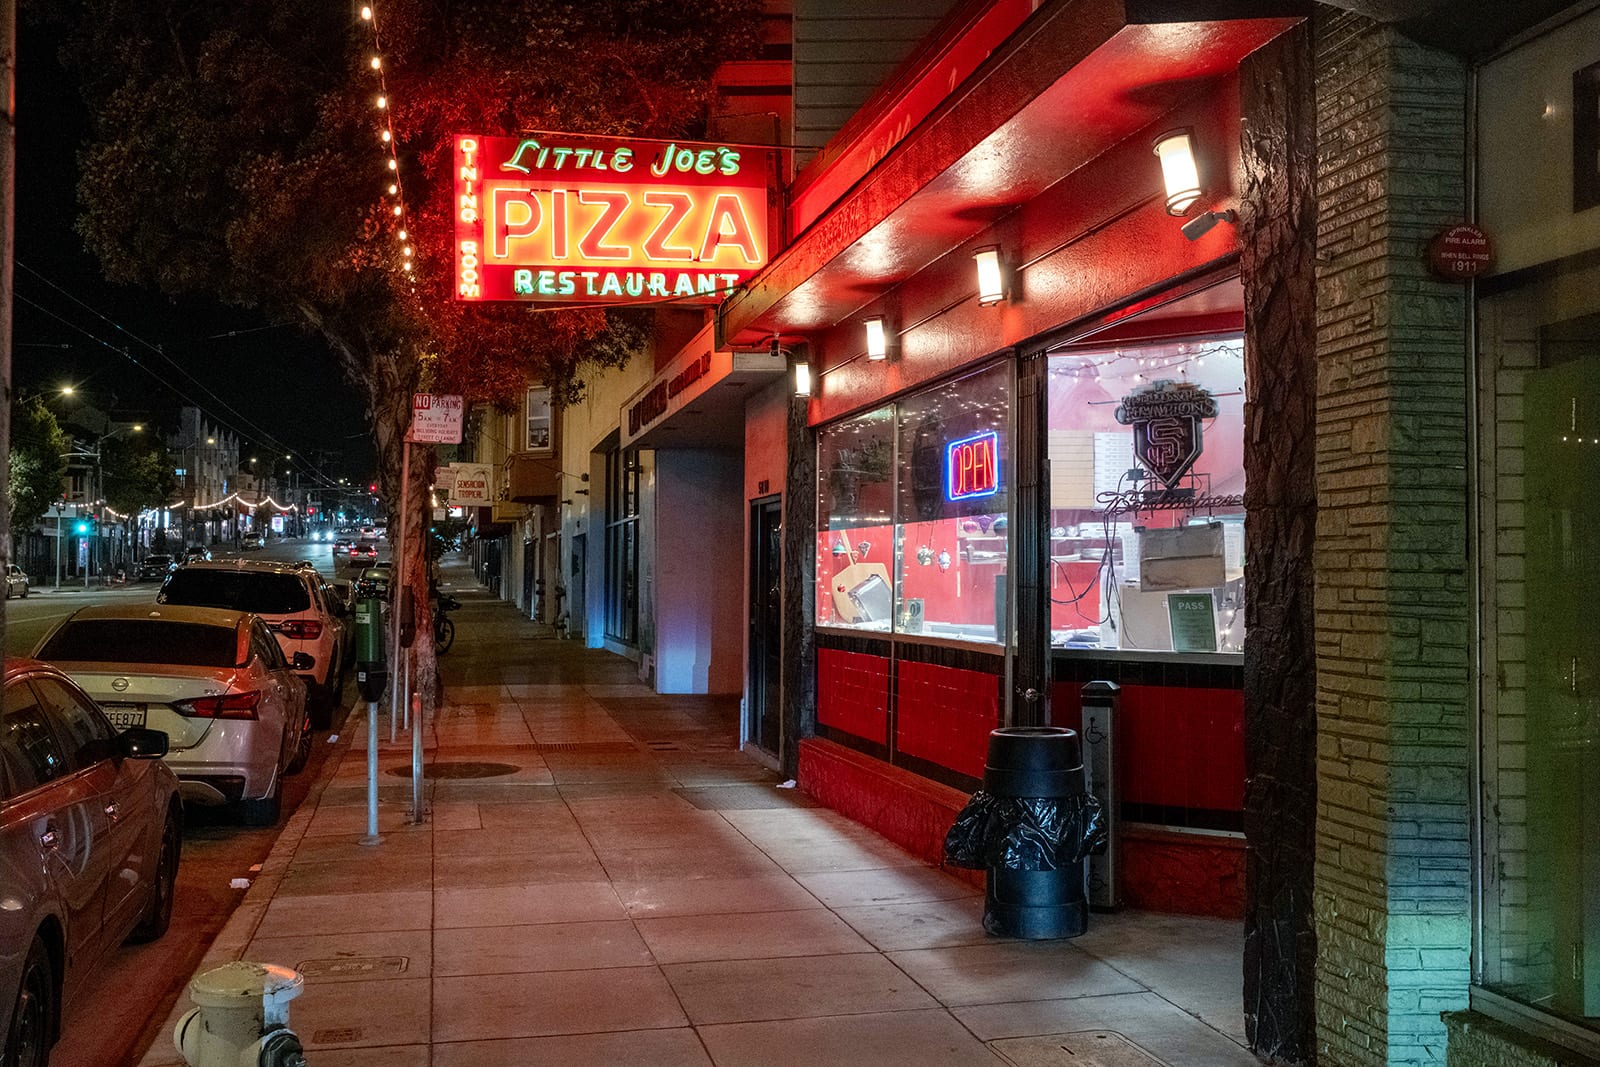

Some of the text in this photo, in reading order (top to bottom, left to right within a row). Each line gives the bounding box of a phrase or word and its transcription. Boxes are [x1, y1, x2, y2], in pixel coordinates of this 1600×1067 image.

[501, 140, 741, 177] LITTLE JOE'S
[460, 139, 480, 297] DINING ROOM
[492, 187, 760, 263] PIZZA
[1449, 226, 1483, 239] SPRINKLER
[1457, 260, 1477, 272] 911
[514, 269, 739, 296] RESTAURANT
[415, 395, 461, 410] NO PARKING
[952, 438, 995, 496] OPEN
[1178, 601, 1205, 610] PASS
